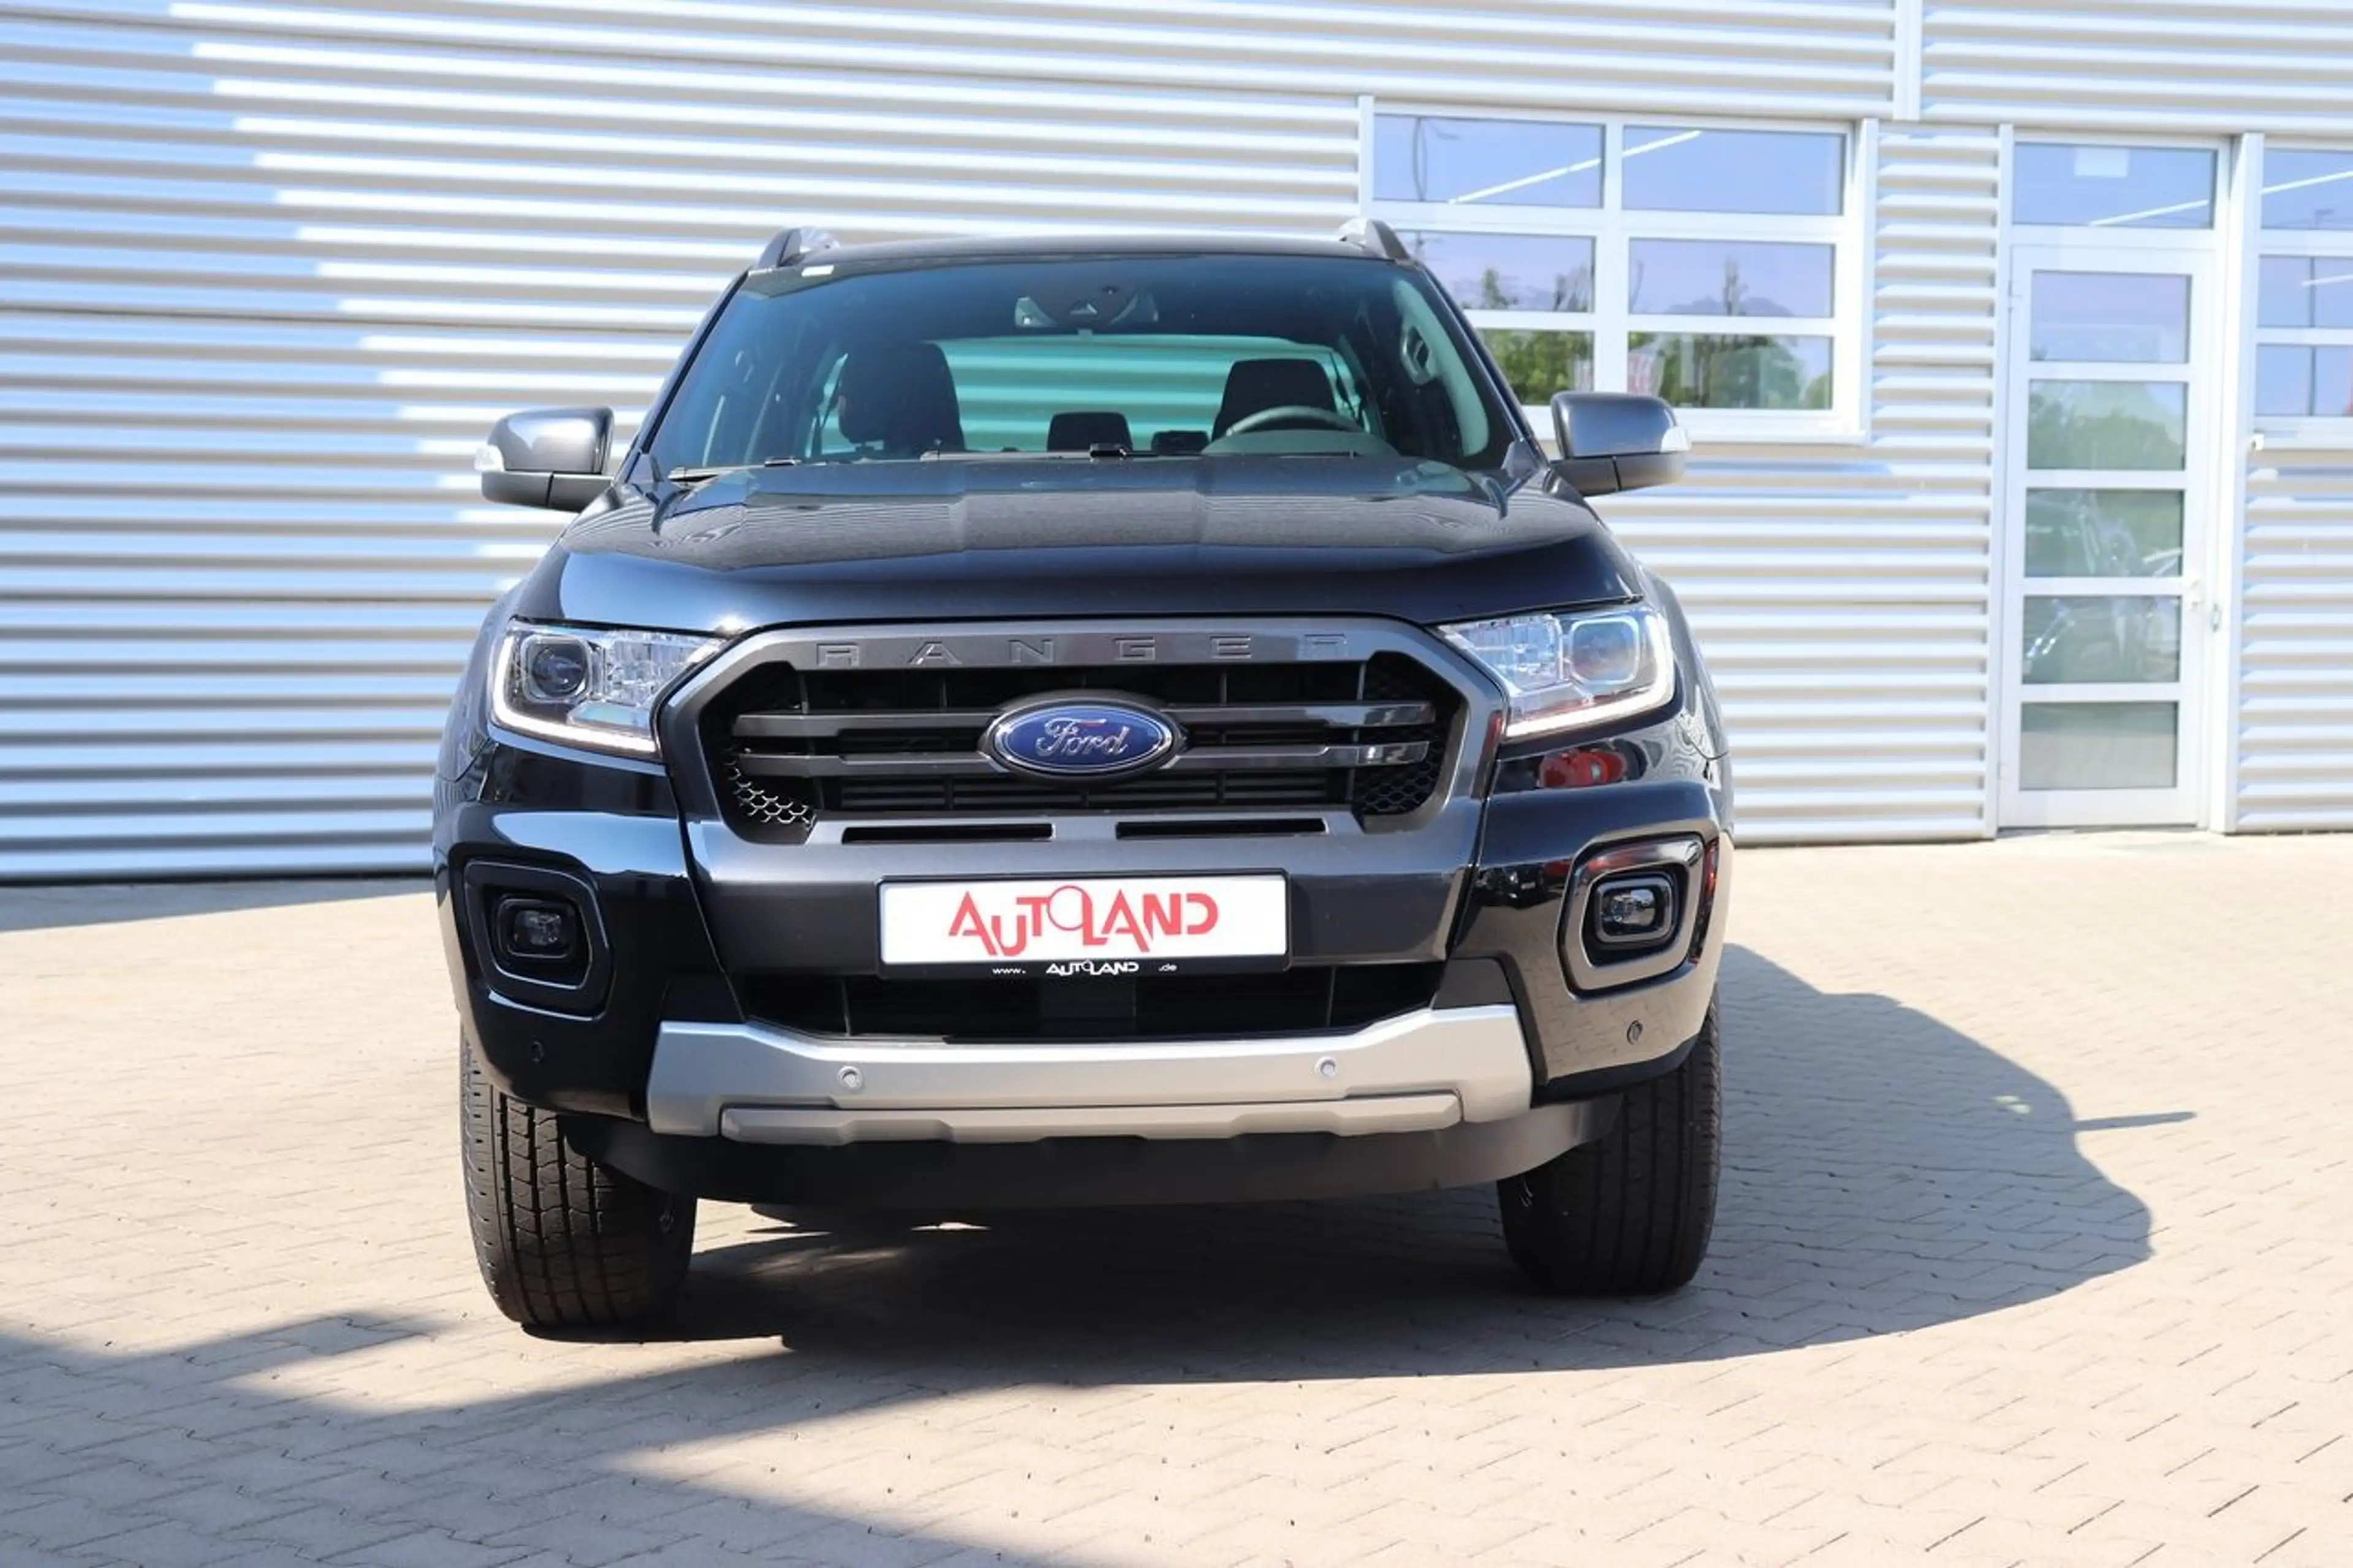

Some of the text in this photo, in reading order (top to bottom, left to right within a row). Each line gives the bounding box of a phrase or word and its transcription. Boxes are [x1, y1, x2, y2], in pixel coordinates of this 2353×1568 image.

[816, 634, 1347, 667] RANGER
[1035, 718, 1130, 757] Ford
[949, 885, 1218, 956] AUTOLAND
[1045, 960, 1140, 976] AUTOLAND
